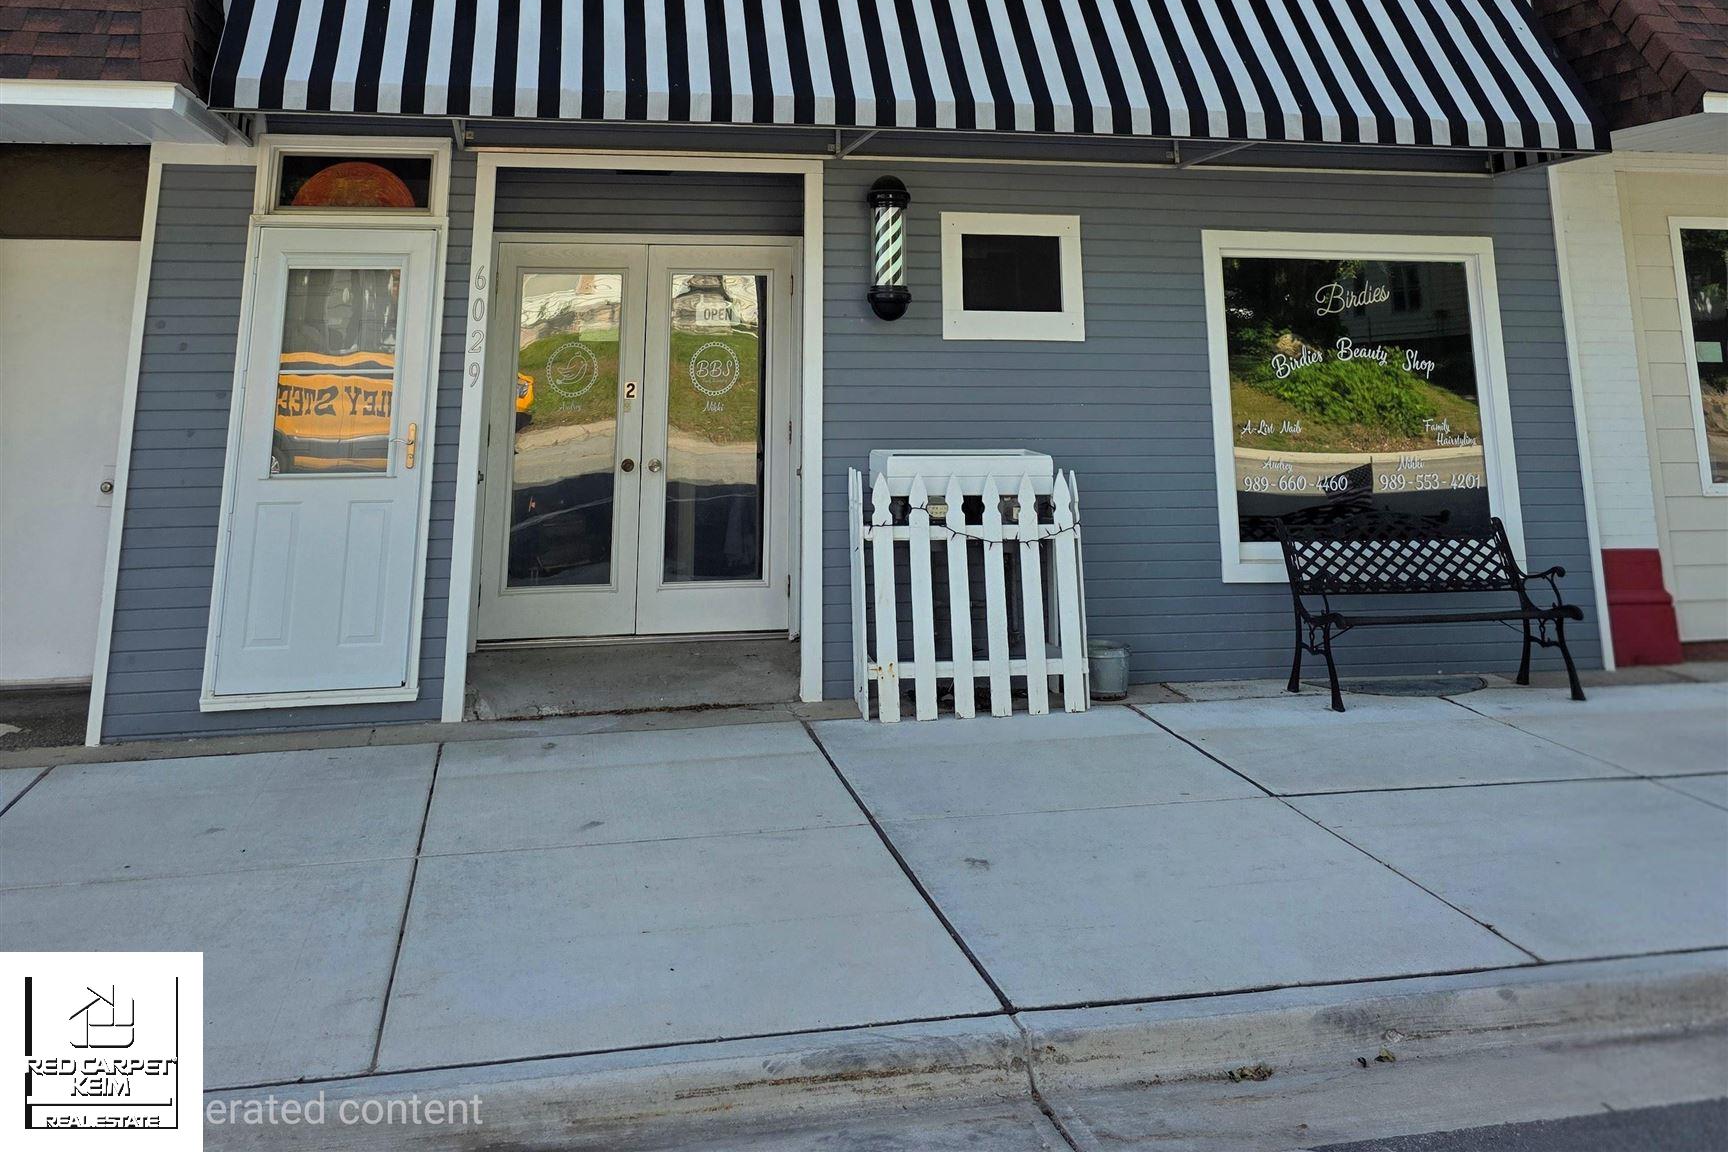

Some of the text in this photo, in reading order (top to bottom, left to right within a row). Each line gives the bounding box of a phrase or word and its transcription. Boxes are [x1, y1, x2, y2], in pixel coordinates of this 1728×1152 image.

[1315, 280, 1390, 317] Birdies
[703, 308, 732, 321] OPEN
[468, 265, 487, 388] 6029
[1271, 337, 1435, 380] Birdies Beauty Shop
[696, 359, 733, 378] BBS
[626, 382, 636, 399] 2
[1240, 419, 1303, 436] A-List Nails
[1422, 417, 1451, 434] Family
[1436, 431, 1477, 448] Hairstyling
[1262, 456, 1293, 474] Audrey
[1243, 474, 1348, 492] 989-660-4460
[1379, 472, 1480, 491] 989-553-4201
